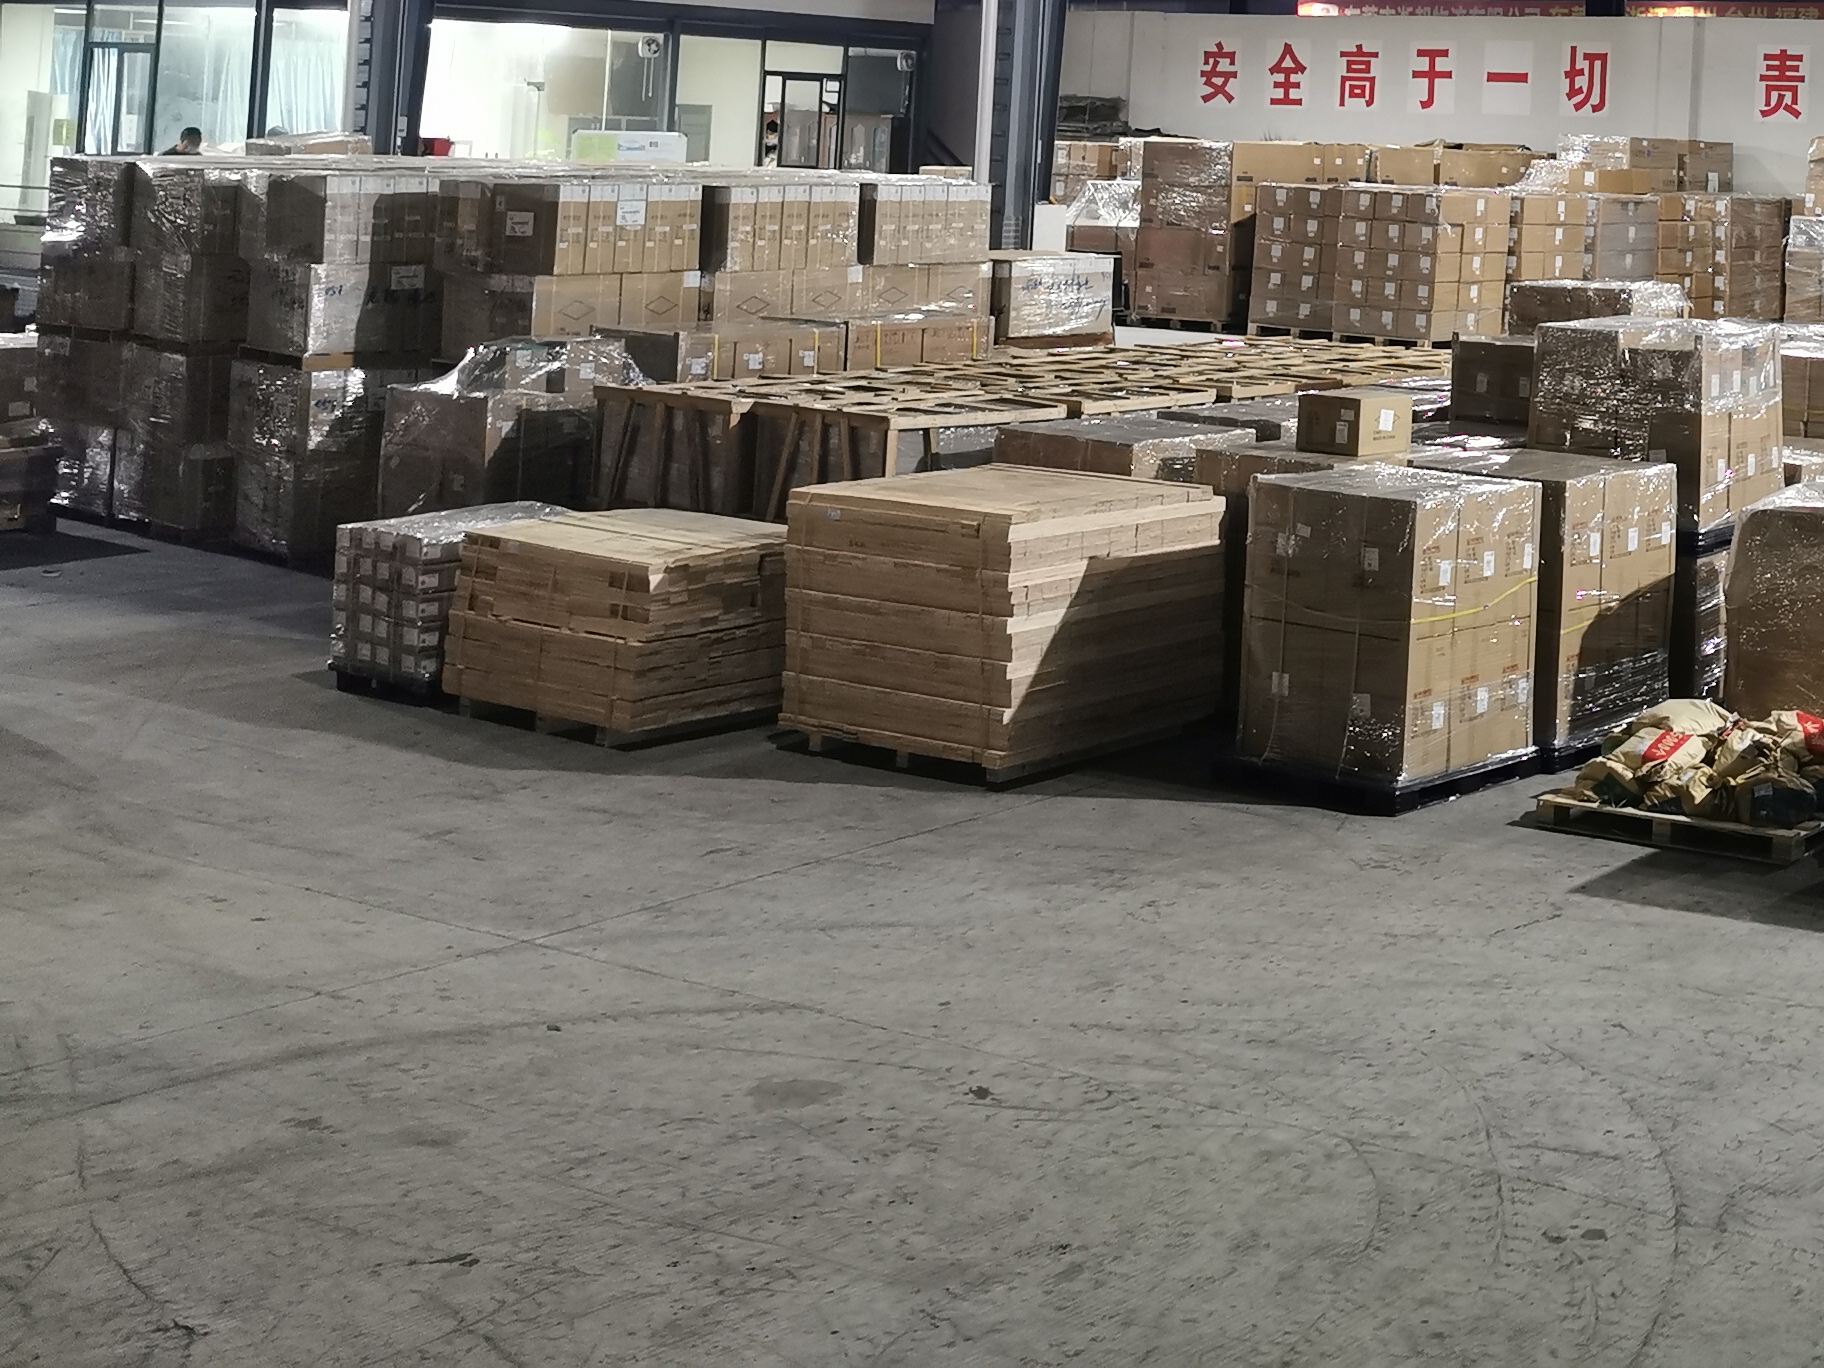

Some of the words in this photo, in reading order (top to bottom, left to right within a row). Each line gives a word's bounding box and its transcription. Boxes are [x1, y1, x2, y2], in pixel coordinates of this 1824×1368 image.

[1200, 42, 1609, 115] 安全高于一切
